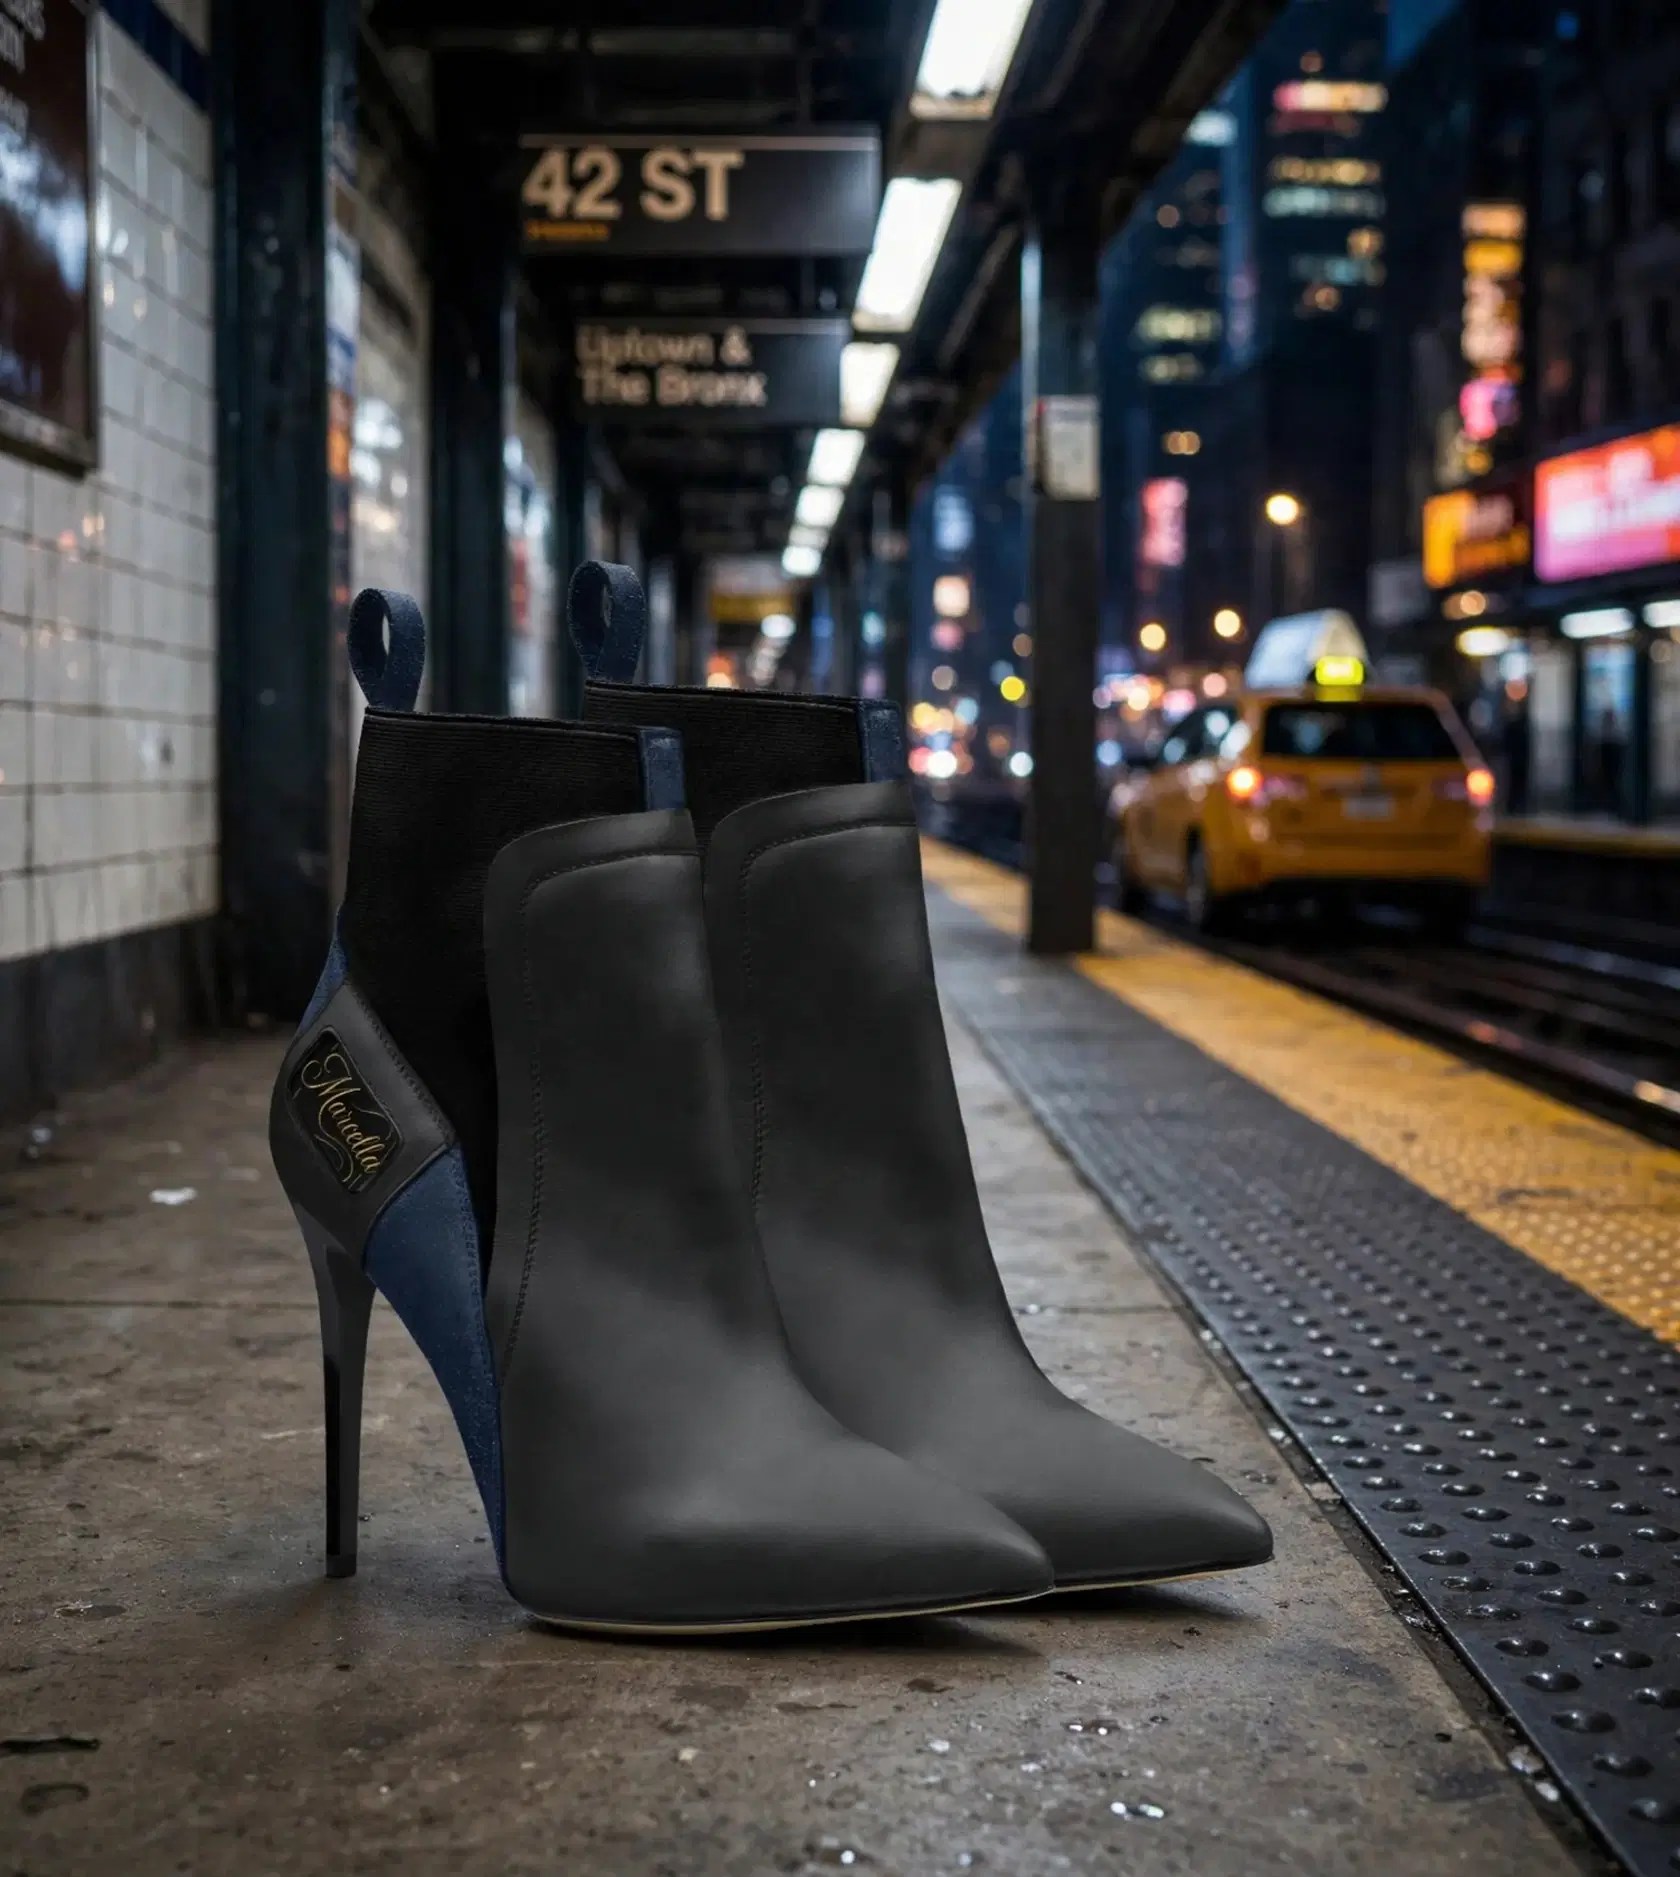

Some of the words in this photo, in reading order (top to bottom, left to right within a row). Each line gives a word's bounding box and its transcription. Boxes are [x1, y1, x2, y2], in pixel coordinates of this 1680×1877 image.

[523, 147, 621, 219] 42
[640, 147, 744, 221] ST
[577, 327, 714, 367] Uptown
[719, 325, 751, 364] &
[578, 367, 649, 404] The
[656, 366, 768, 406] Bronx
[301, 1053, 386, 1180] Marcella
